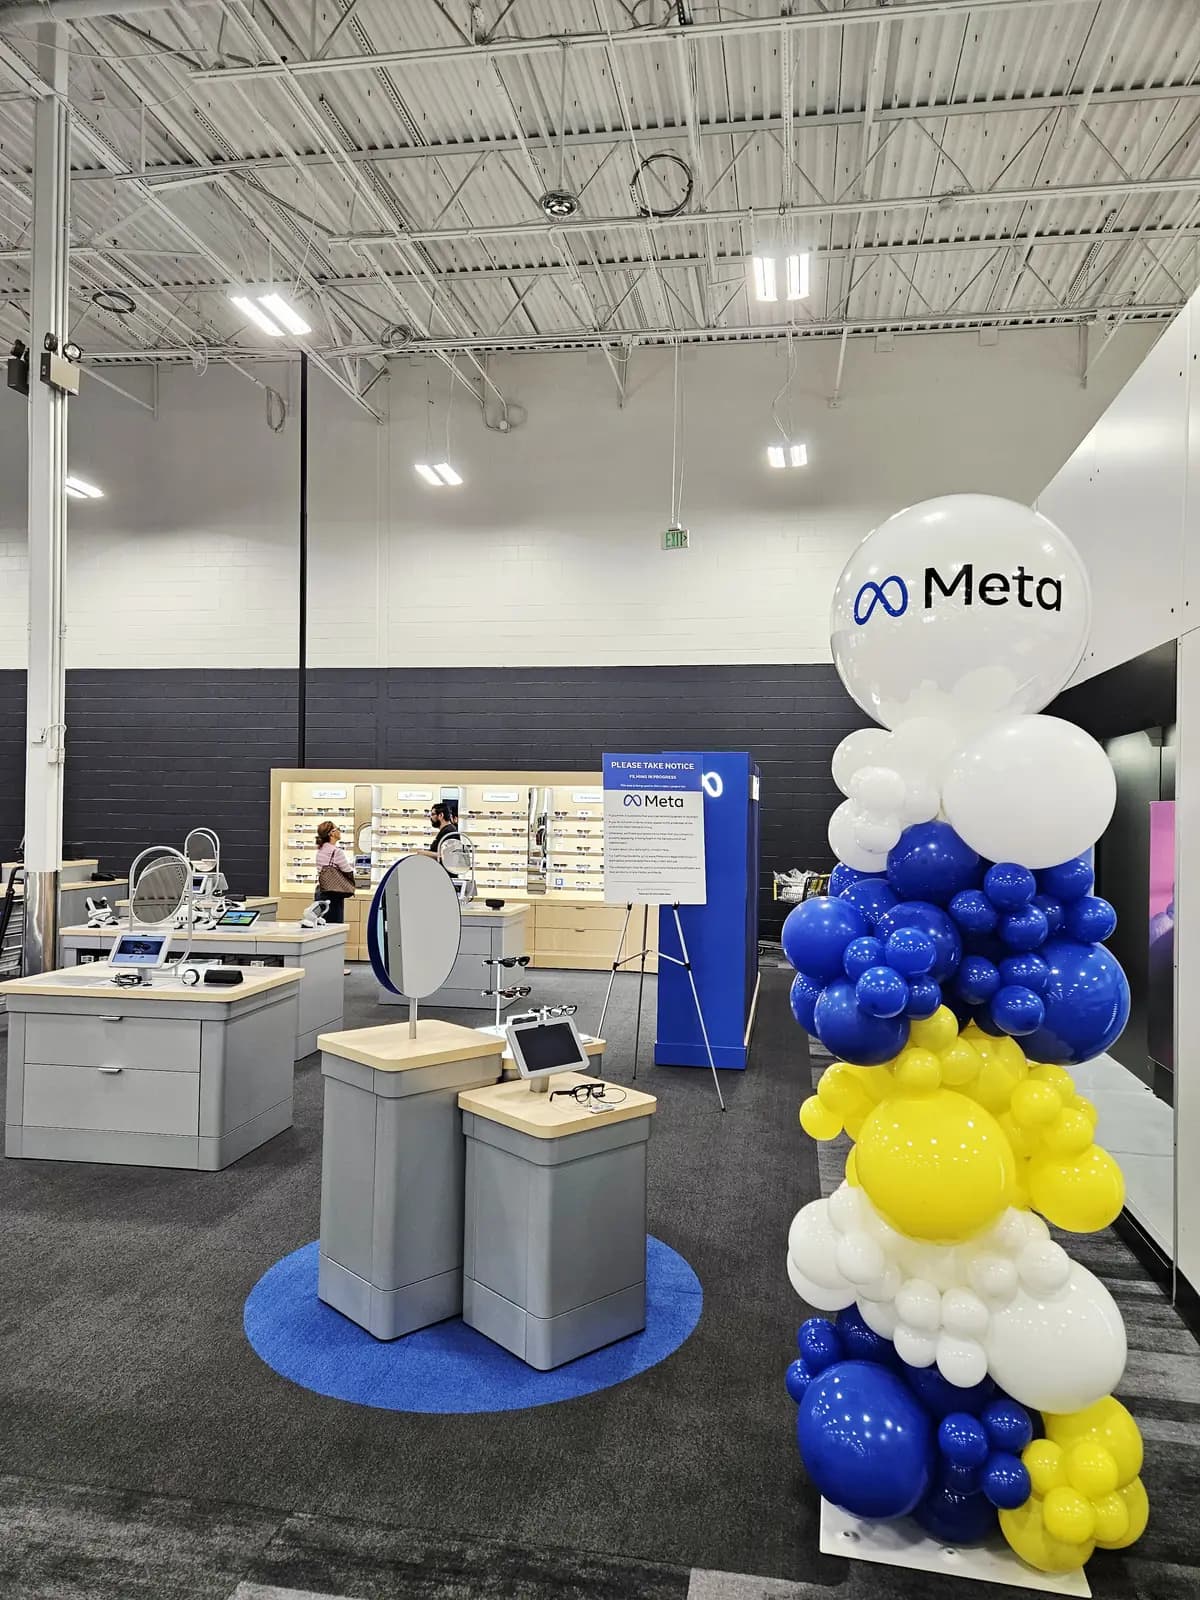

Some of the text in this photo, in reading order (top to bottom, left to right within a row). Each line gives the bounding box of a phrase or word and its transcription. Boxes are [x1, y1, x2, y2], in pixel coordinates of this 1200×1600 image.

[665, 531, 685, 547] EXIT
[924, 564, 1062, 612] Meta
[611, 761, 695, 770] PLEASE TAKE NOTICE
[645, 795, 684, 808] Meta
